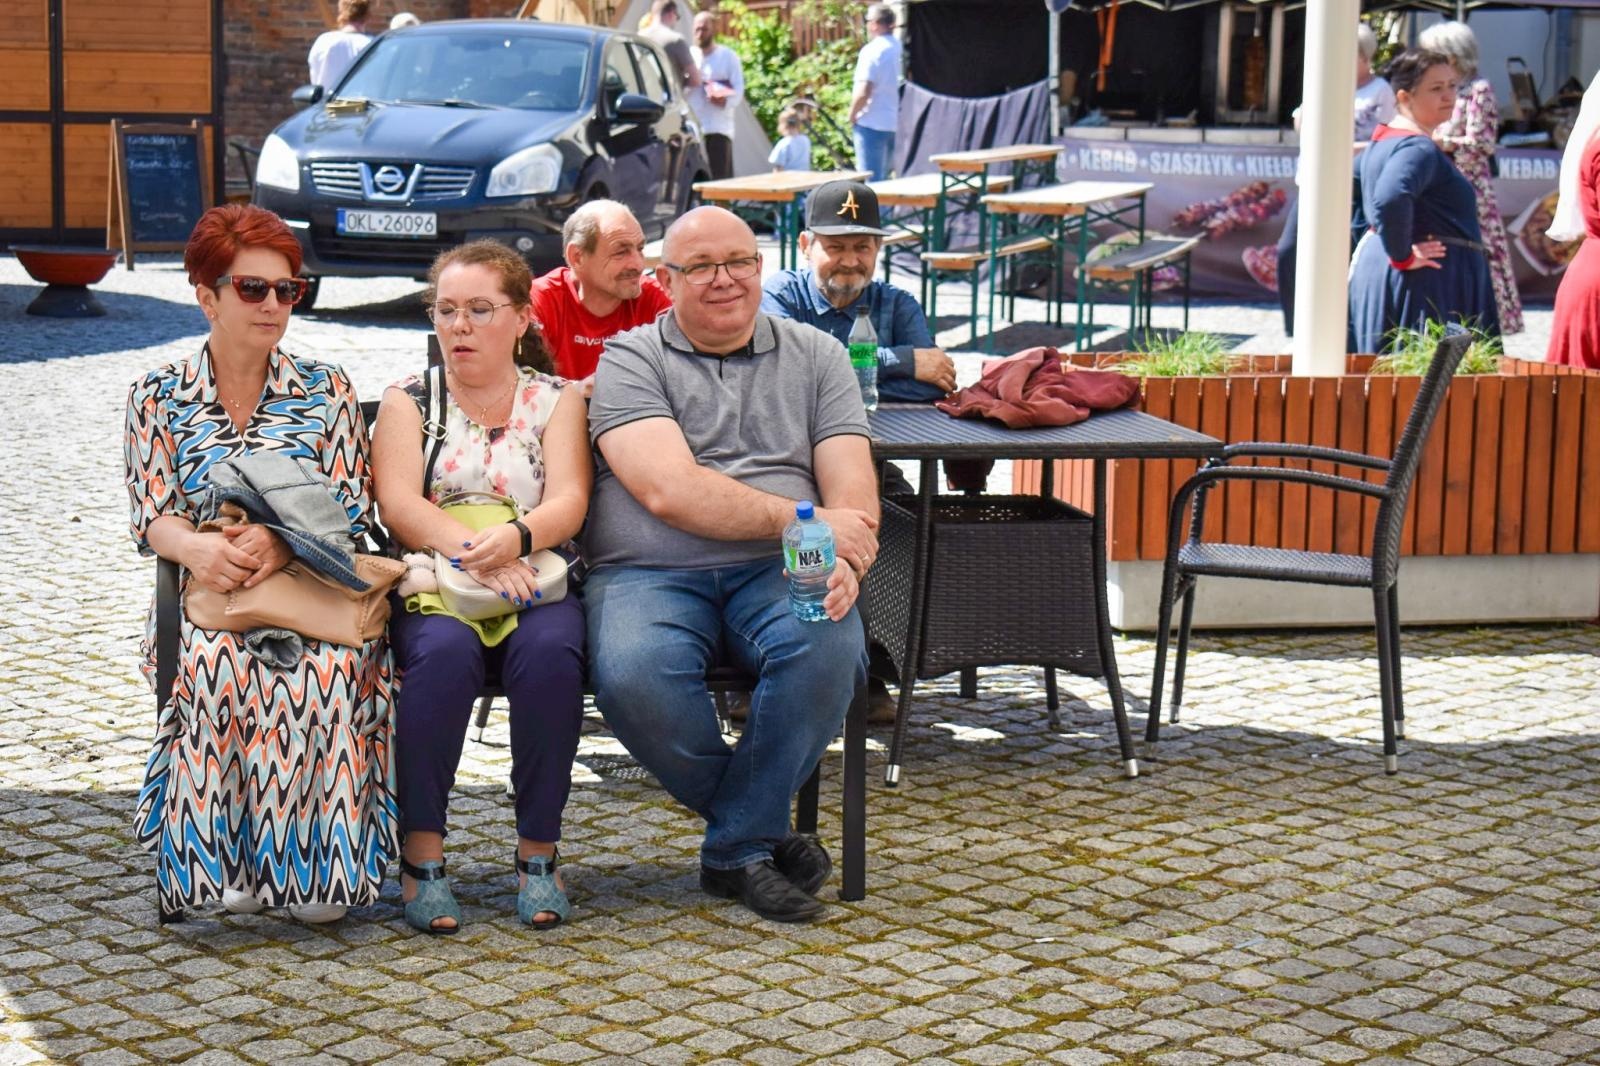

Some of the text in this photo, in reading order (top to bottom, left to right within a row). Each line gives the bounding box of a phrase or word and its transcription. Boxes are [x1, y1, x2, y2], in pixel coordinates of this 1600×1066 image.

[1079, 148, 1137, 173] KEBAB
[1149, 151, 1234, 176] SZASZŁYK
[1498, 157, 1557, 179] KEBAB
[836, 189, 860, 220] A
[383, 214, 434, 233] 26096
